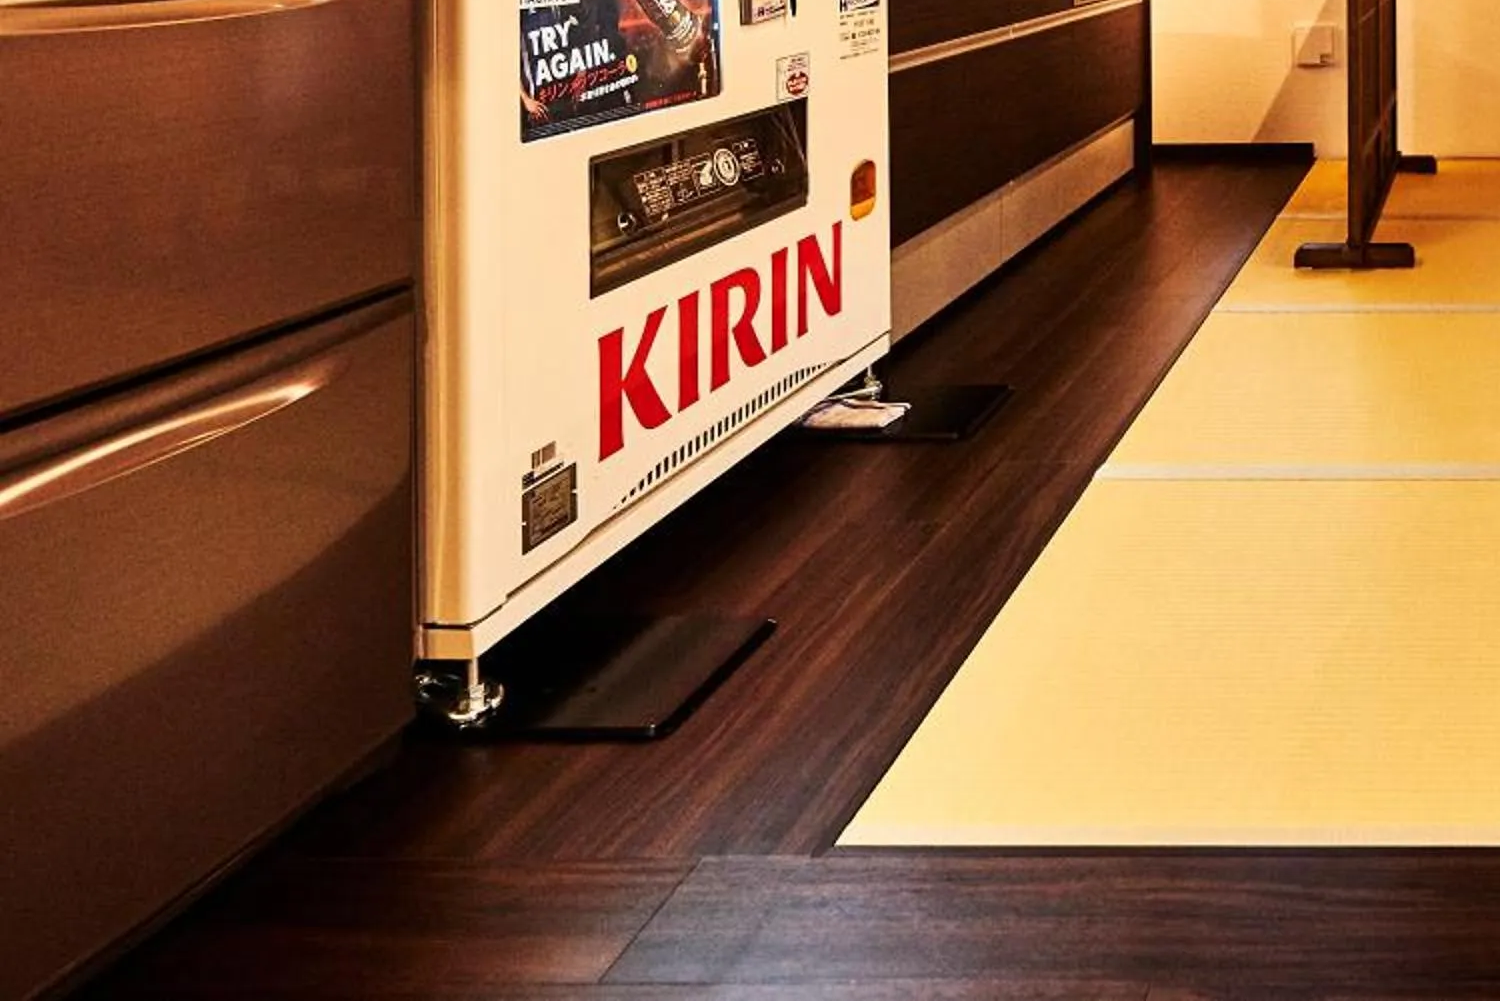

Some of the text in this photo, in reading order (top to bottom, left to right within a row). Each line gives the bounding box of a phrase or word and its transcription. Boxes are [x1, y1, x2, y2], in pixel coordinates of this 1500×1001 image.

[527, 22, 571, 56] TRY
[534, 38, 617, 88] AGAIN.
[598, 220, 842, 463] KIRIN
